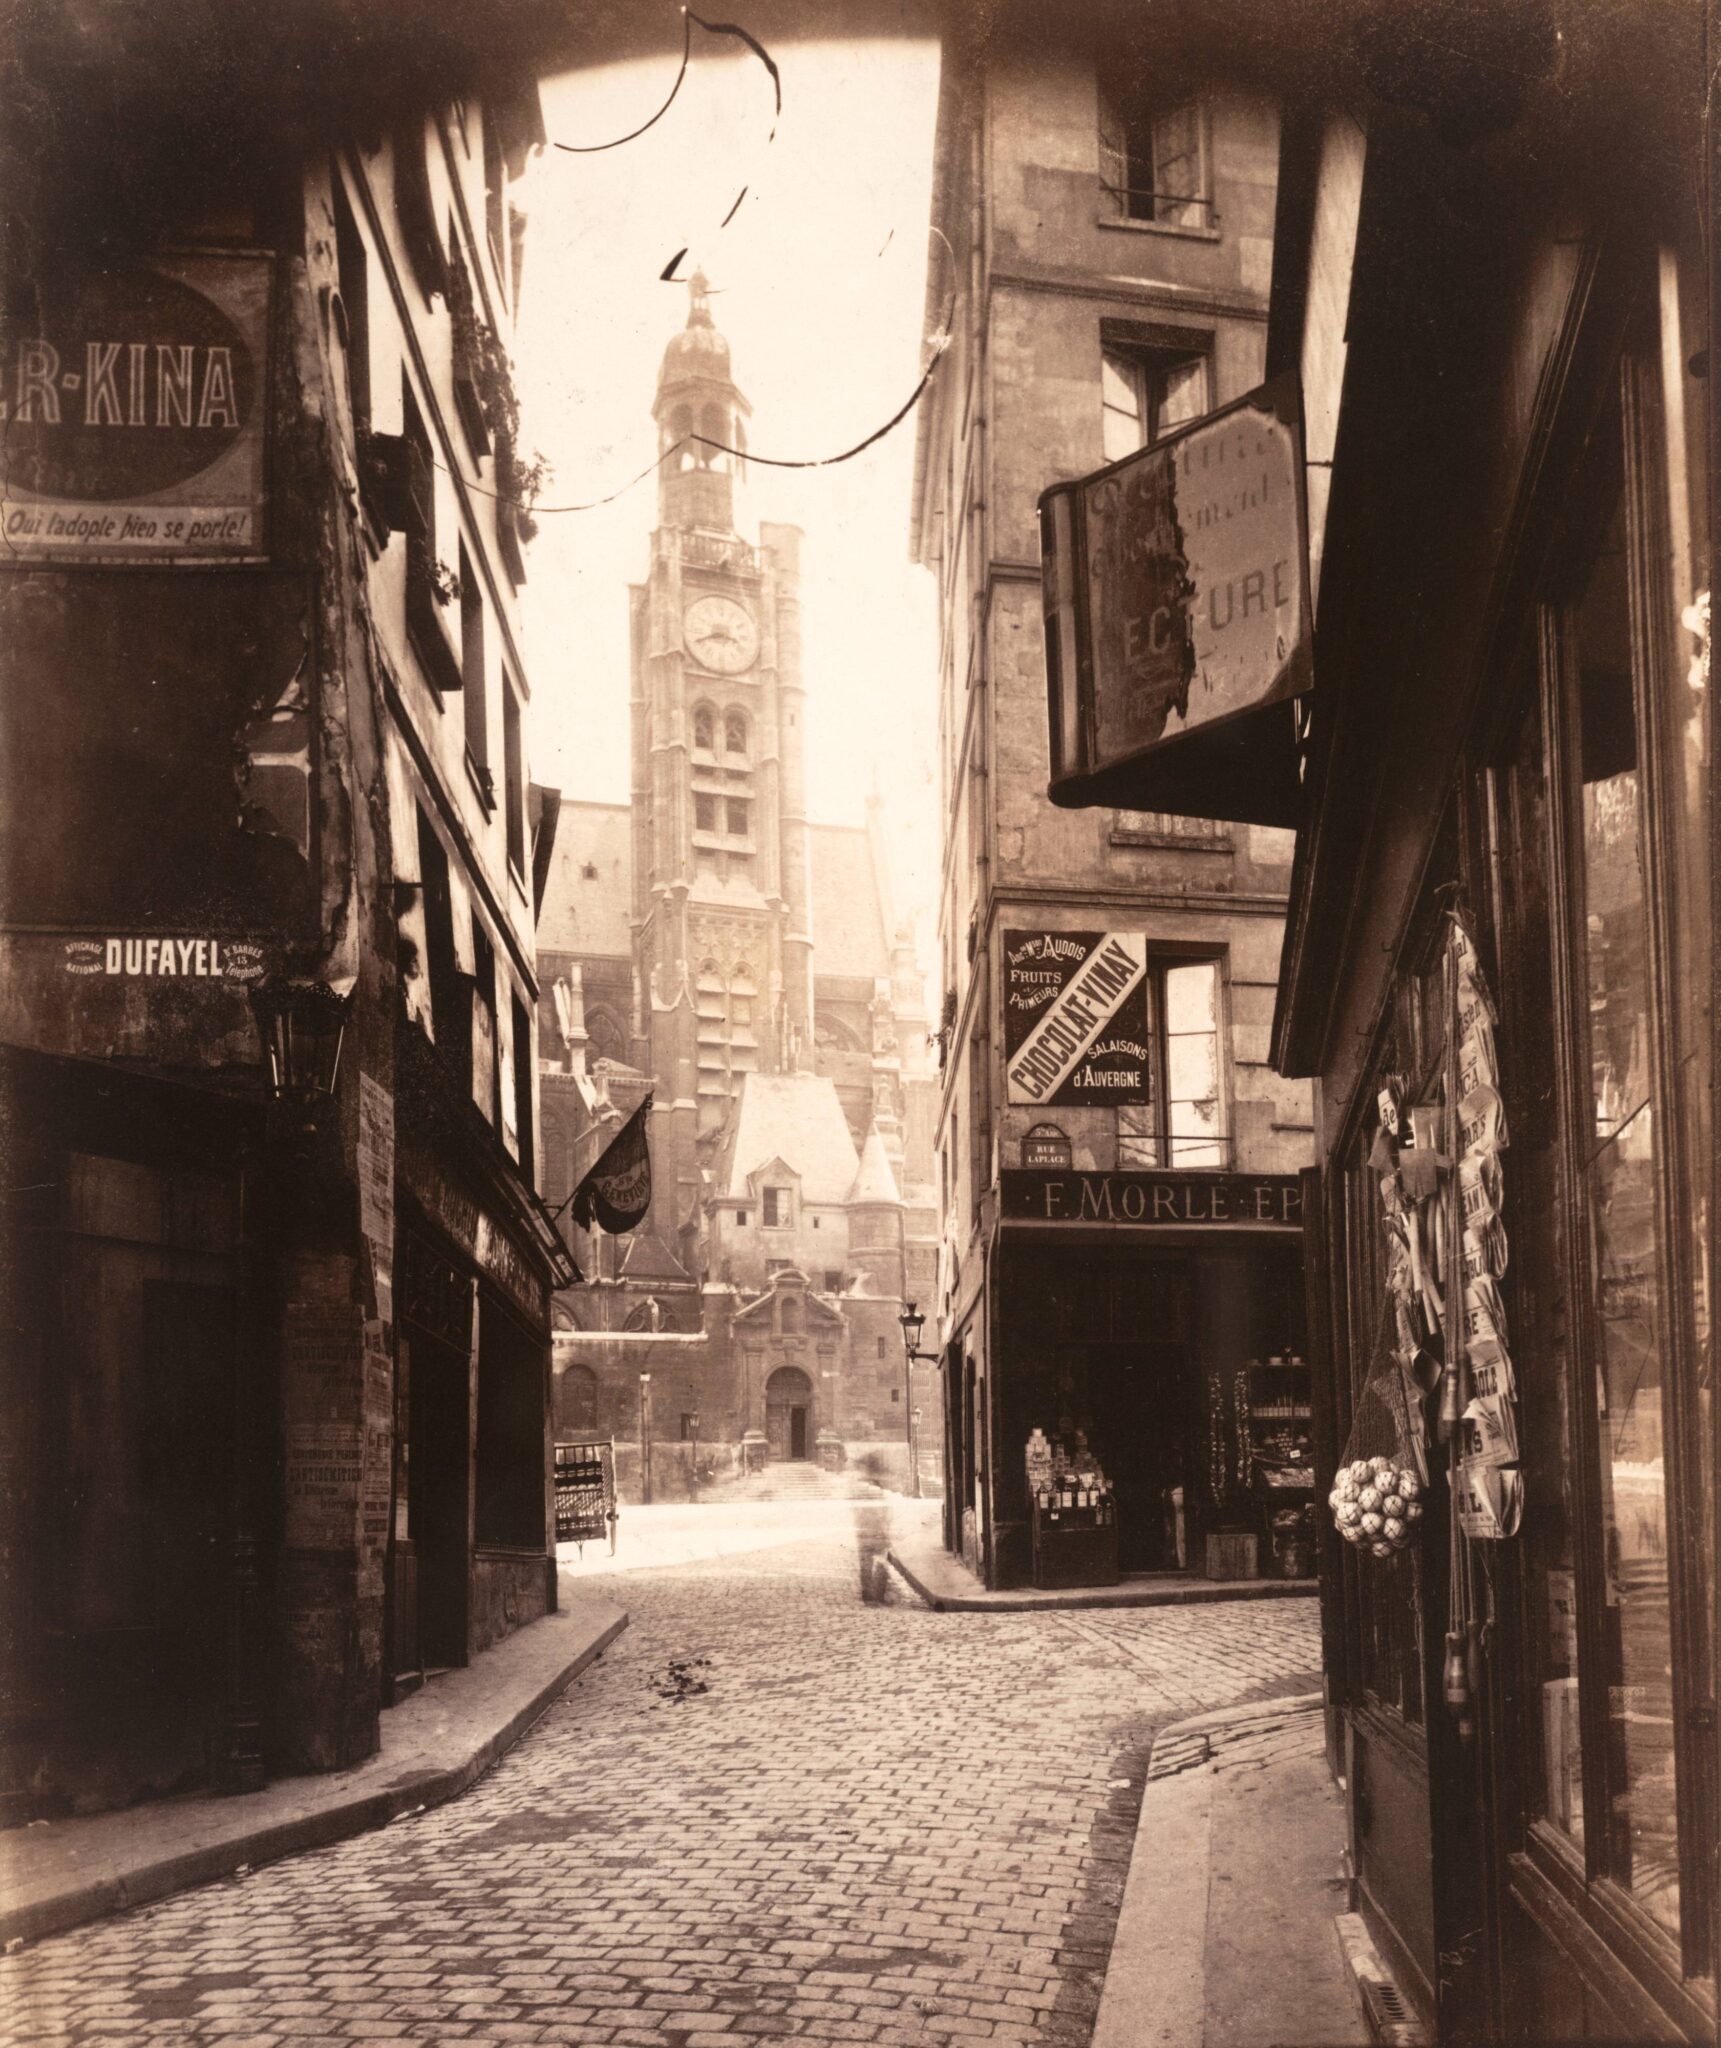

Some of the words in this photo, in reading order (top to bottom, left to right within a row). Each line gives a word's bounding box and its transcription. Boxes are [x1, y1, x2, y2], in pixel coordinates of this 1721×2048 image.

[0, 339, 240, 427] R-KINA
[46, 511, 116, 543] l'adopte
[119, 512, 157, 541] bien
[164, 520, 185, 539] se
[185, 514, 247, 545] porte!
[65, 961, 104, 976] NATIONAL
[105, 938, 224, 977] DUFAYEL
[1010, 969, 1063, 985] FRUITS
[1008, 986, 1059, 1011] PRIMEURS
[1010, 939, 1140, 1100] CHOCOLAT-VINAY
[1087, 1040, 1148, 1061] SALAISONS
[1073, 1064, 1142, 1088] d'AUVERGNE
[1027, 1155, 1066, 1164] LAPLACE
[1036, 1145, 1056, 1154] RUE
